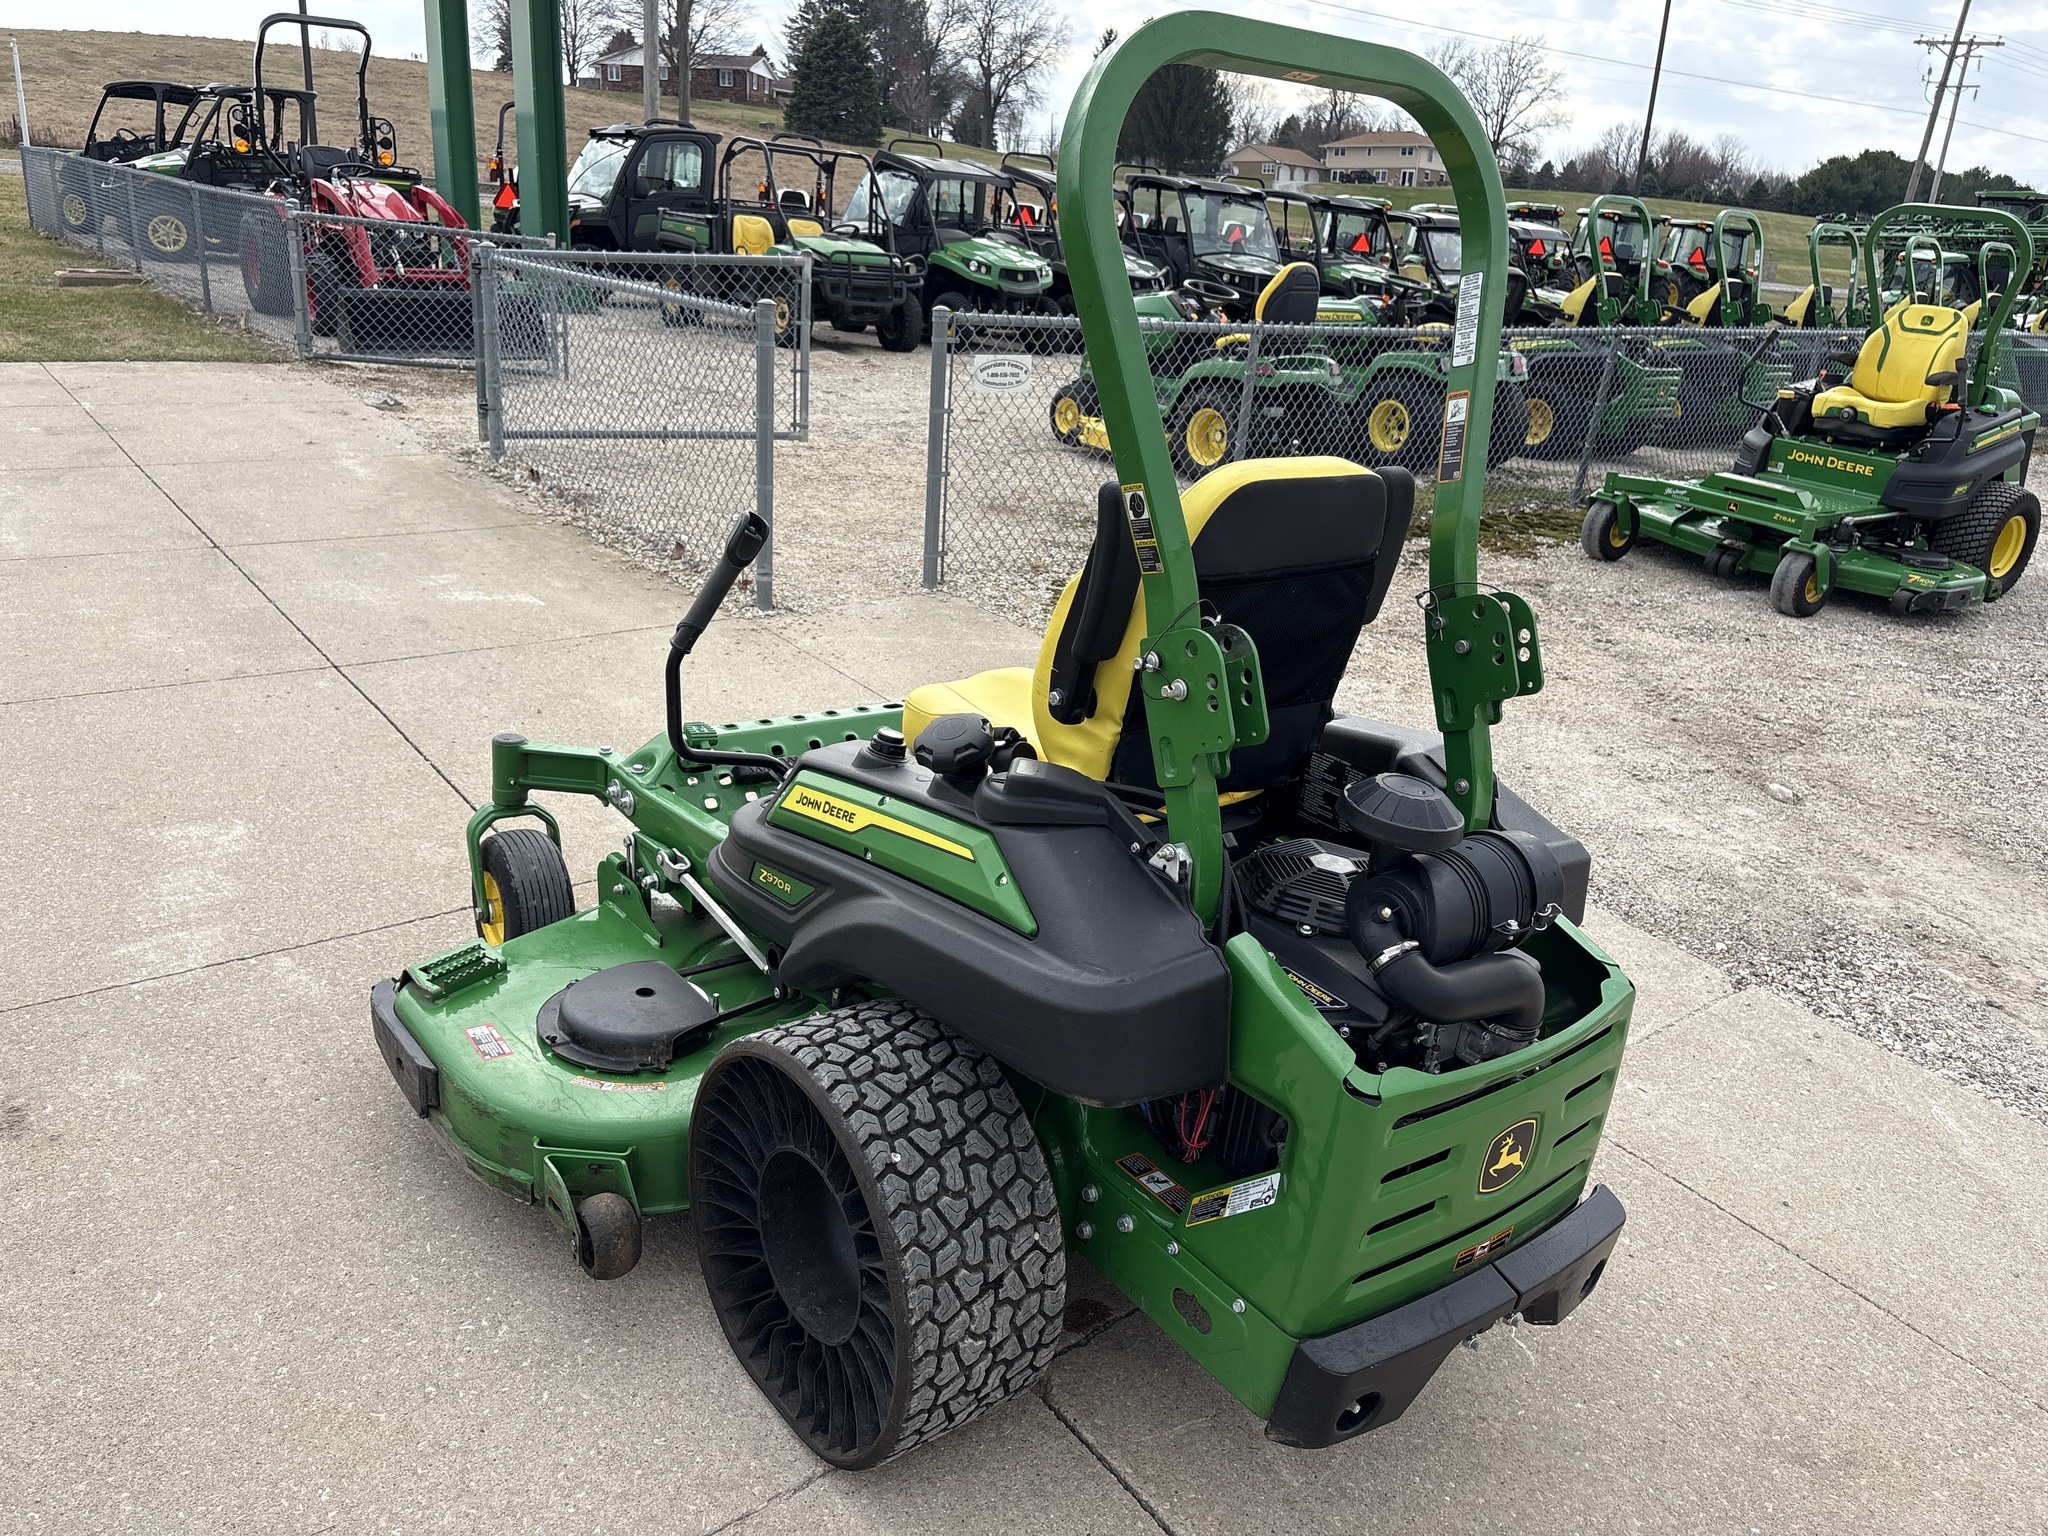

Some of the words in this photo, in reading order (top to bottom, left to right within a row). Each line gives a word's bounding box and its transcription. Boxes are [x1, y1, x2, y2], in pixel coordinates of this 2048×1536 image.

[979, 362, 1006, 373] Interstate
[1008, 362, 1024, 371] Fence
[1787, 449, 1825, 467] JOHN
[1826, 456, 1875, 477] DEERE
[796, 792, 821, 811] JOHN
[822, 801, 856, 823] DEERE
[759, 867, 792, 895] Z970R
[1305, 984, 1333, 1003] DEERE
[1203, 1191, 1224, 1200] ATENCIÓN
